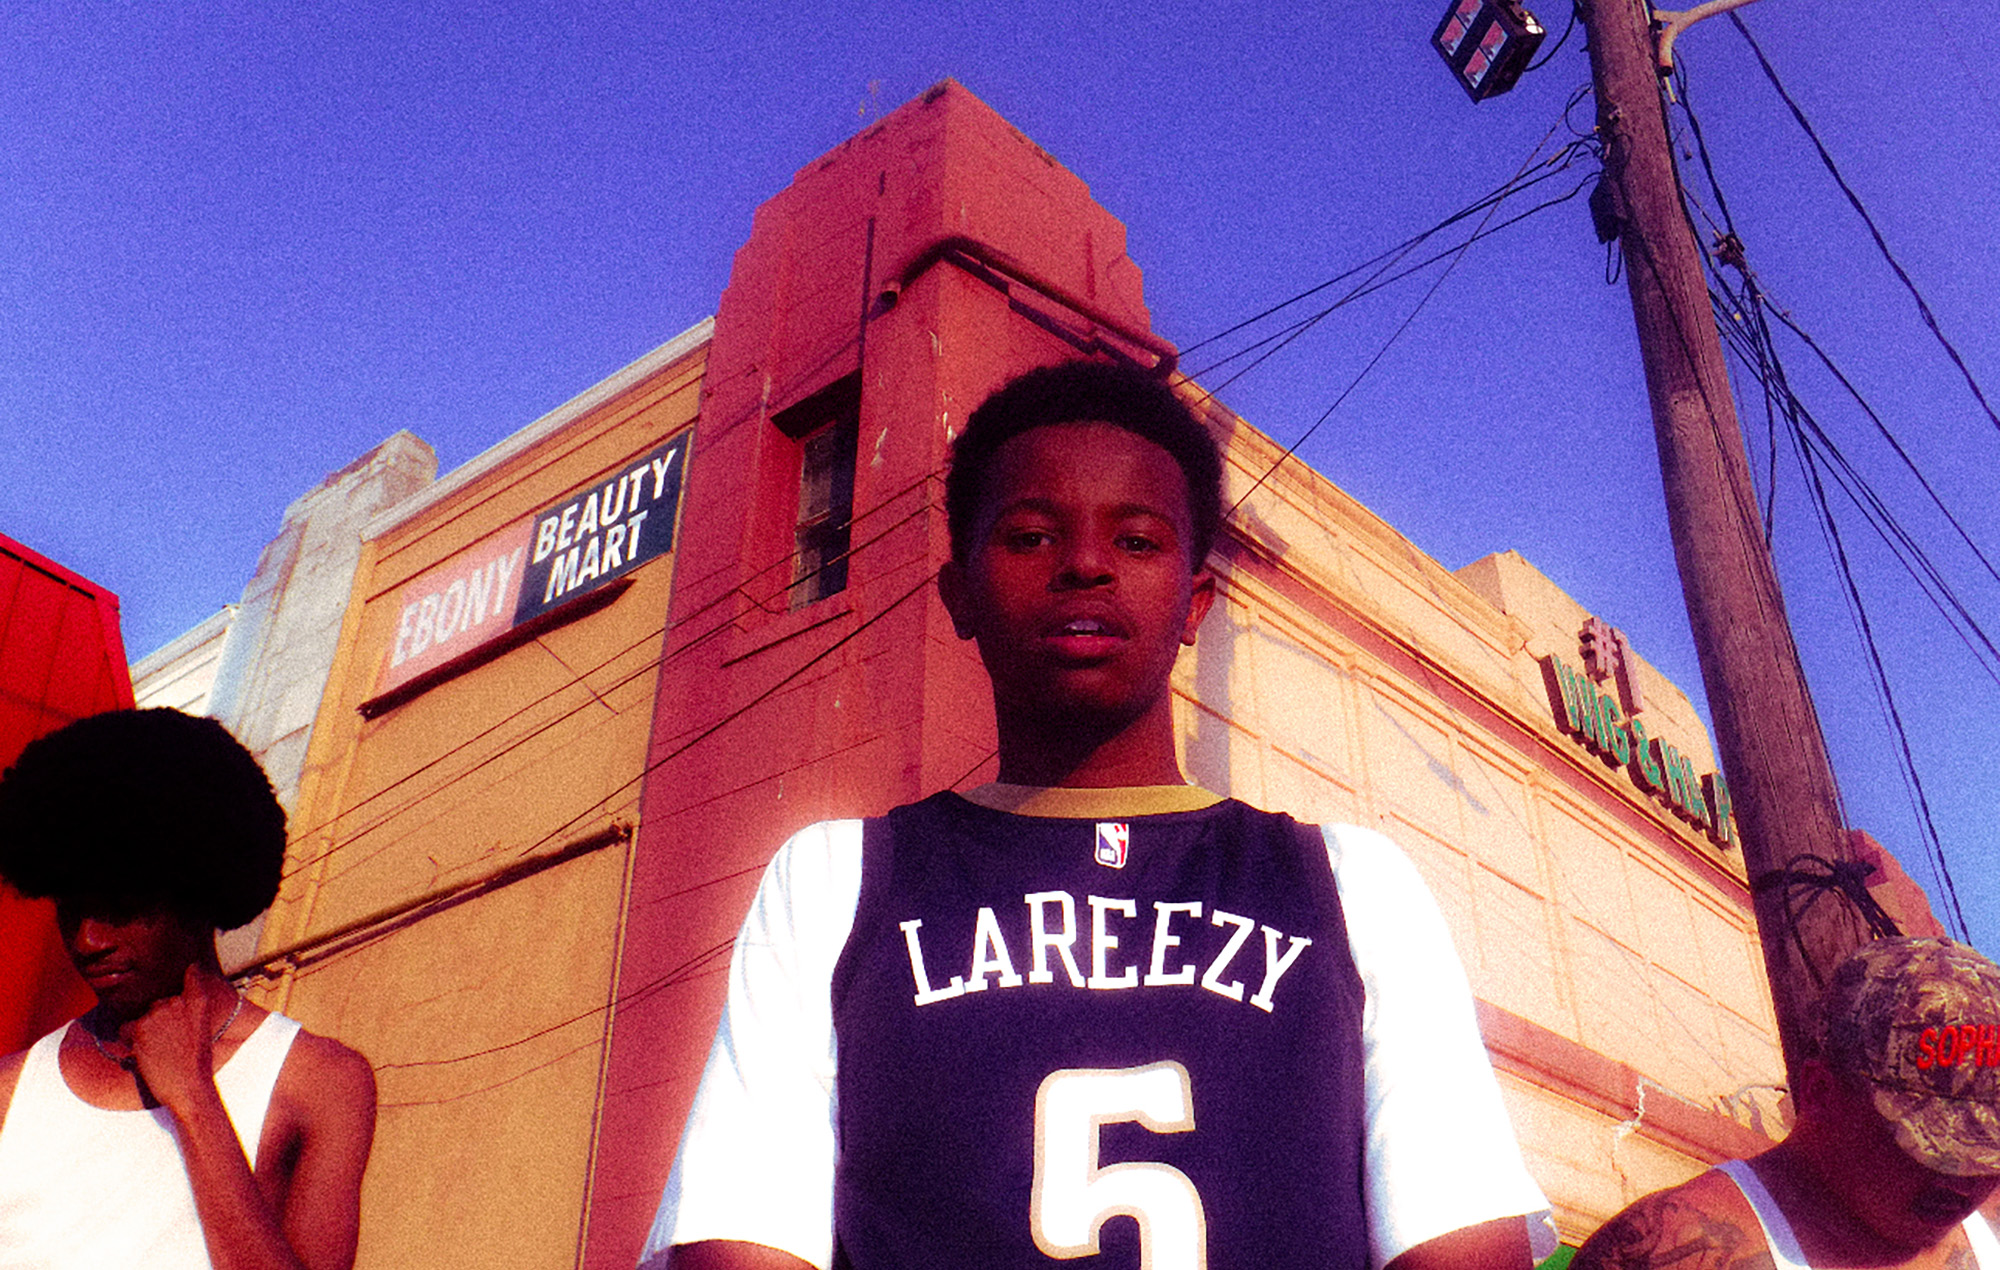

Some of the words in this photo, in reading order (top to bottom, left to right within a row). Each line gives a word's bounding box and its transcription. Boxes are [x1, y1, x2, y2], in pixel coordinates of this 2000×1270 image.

[532, 448, 677, 564] BEAUTY
[543, 509, 648, 604] MART
[390, 546, 523, 669] EBONY
[1579, 615, 1643, 716] #1
[1545, 653, 1630, 767] WIG
[1628, 718, 1666, 795] &
[900, 890, 1312, 1013] LAREEZY
[1029, 1059, 1208, 1270] 5
